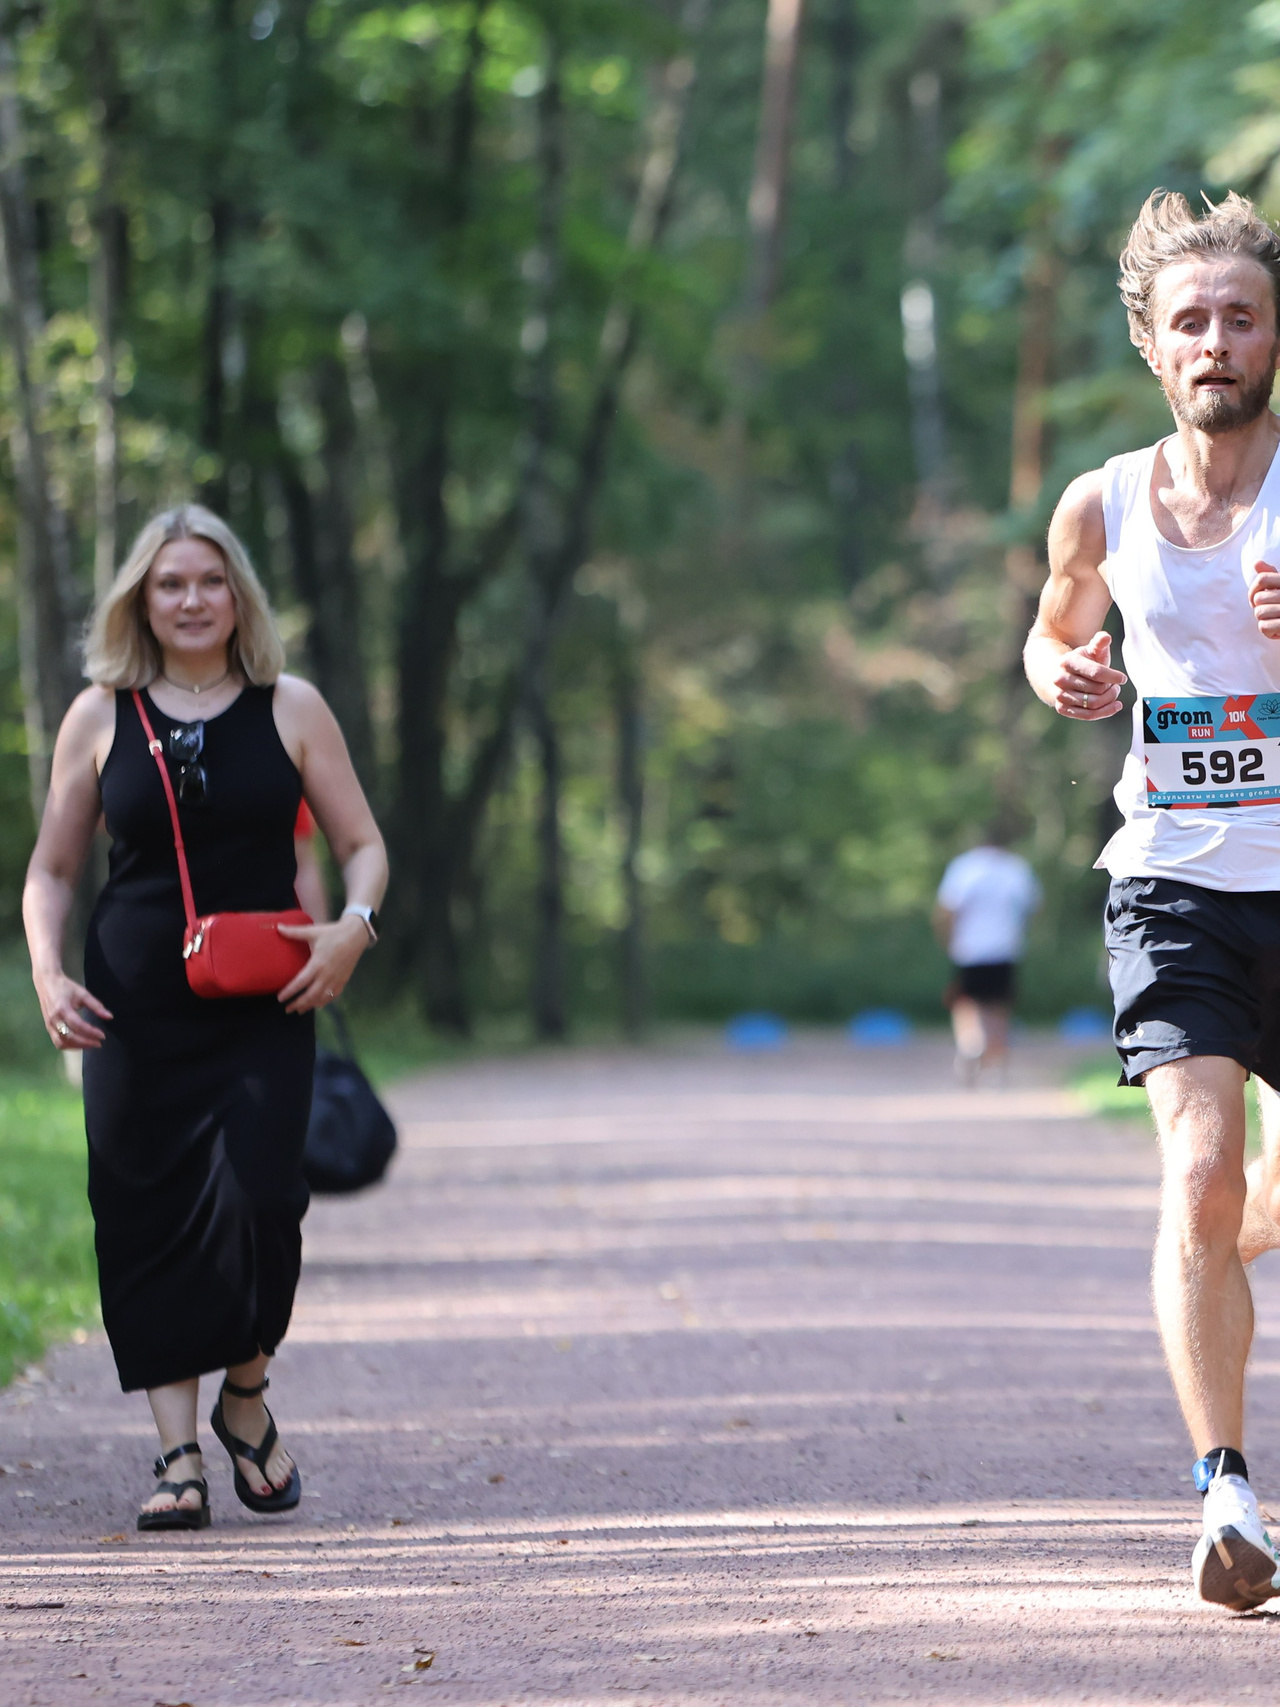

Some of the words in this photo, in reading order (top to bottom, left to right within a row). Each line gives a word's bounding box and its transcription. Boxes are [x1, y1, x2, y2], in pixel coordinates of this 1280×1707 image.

[1156, 709, 1213, 730] grom
[1228, 710, 1247, 723] 10K
[1191, 728, 1211, 738] RUN
[1181, 747, 1265, 786] 592
[1219, 790, 1245, 798] сайте
